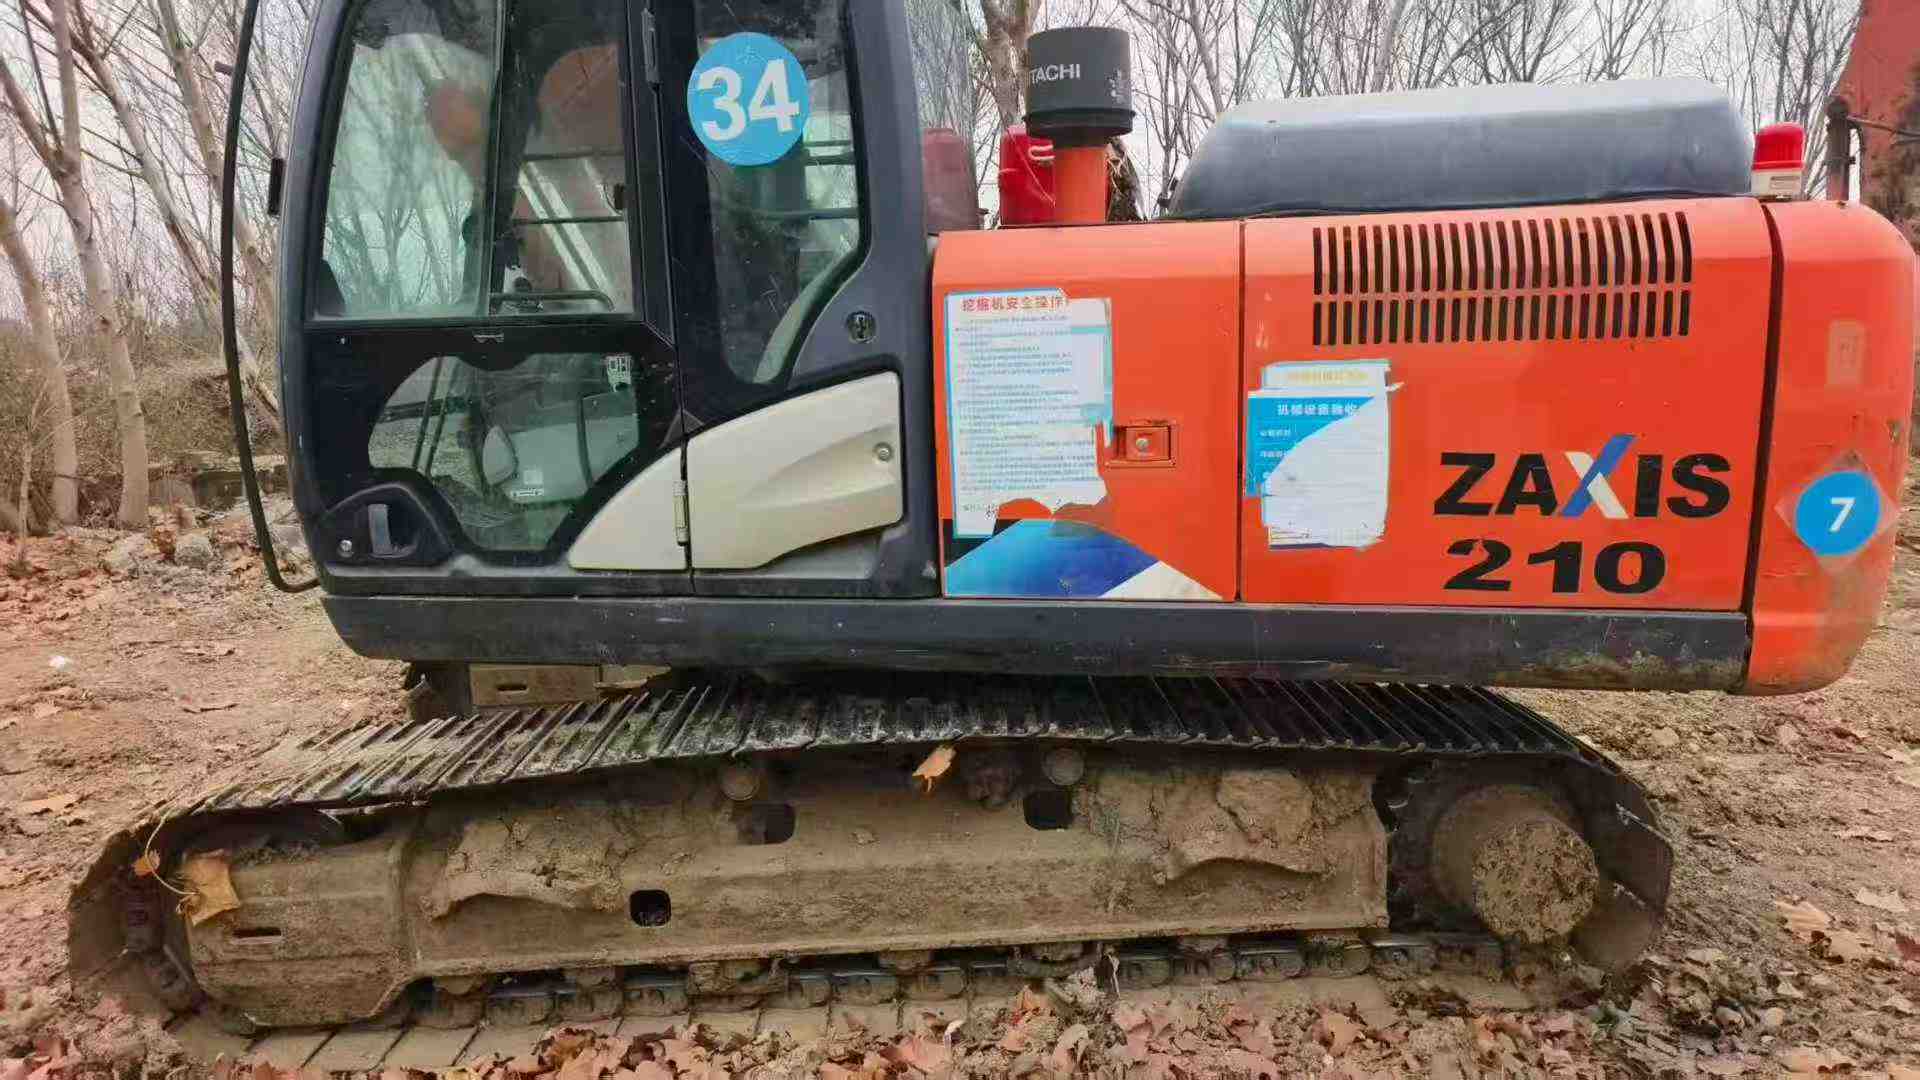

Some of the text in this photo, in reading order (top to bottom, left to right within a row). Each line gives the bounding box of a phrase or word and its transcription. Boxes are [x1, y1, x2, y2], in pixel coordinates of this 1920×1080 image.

[698, 59, 799, 141] 34
[1433, 433, 1731, 519] ZAXIS
[1830, 496, 1856, 532] 7
[1443, 538, 1666, 594] 210
